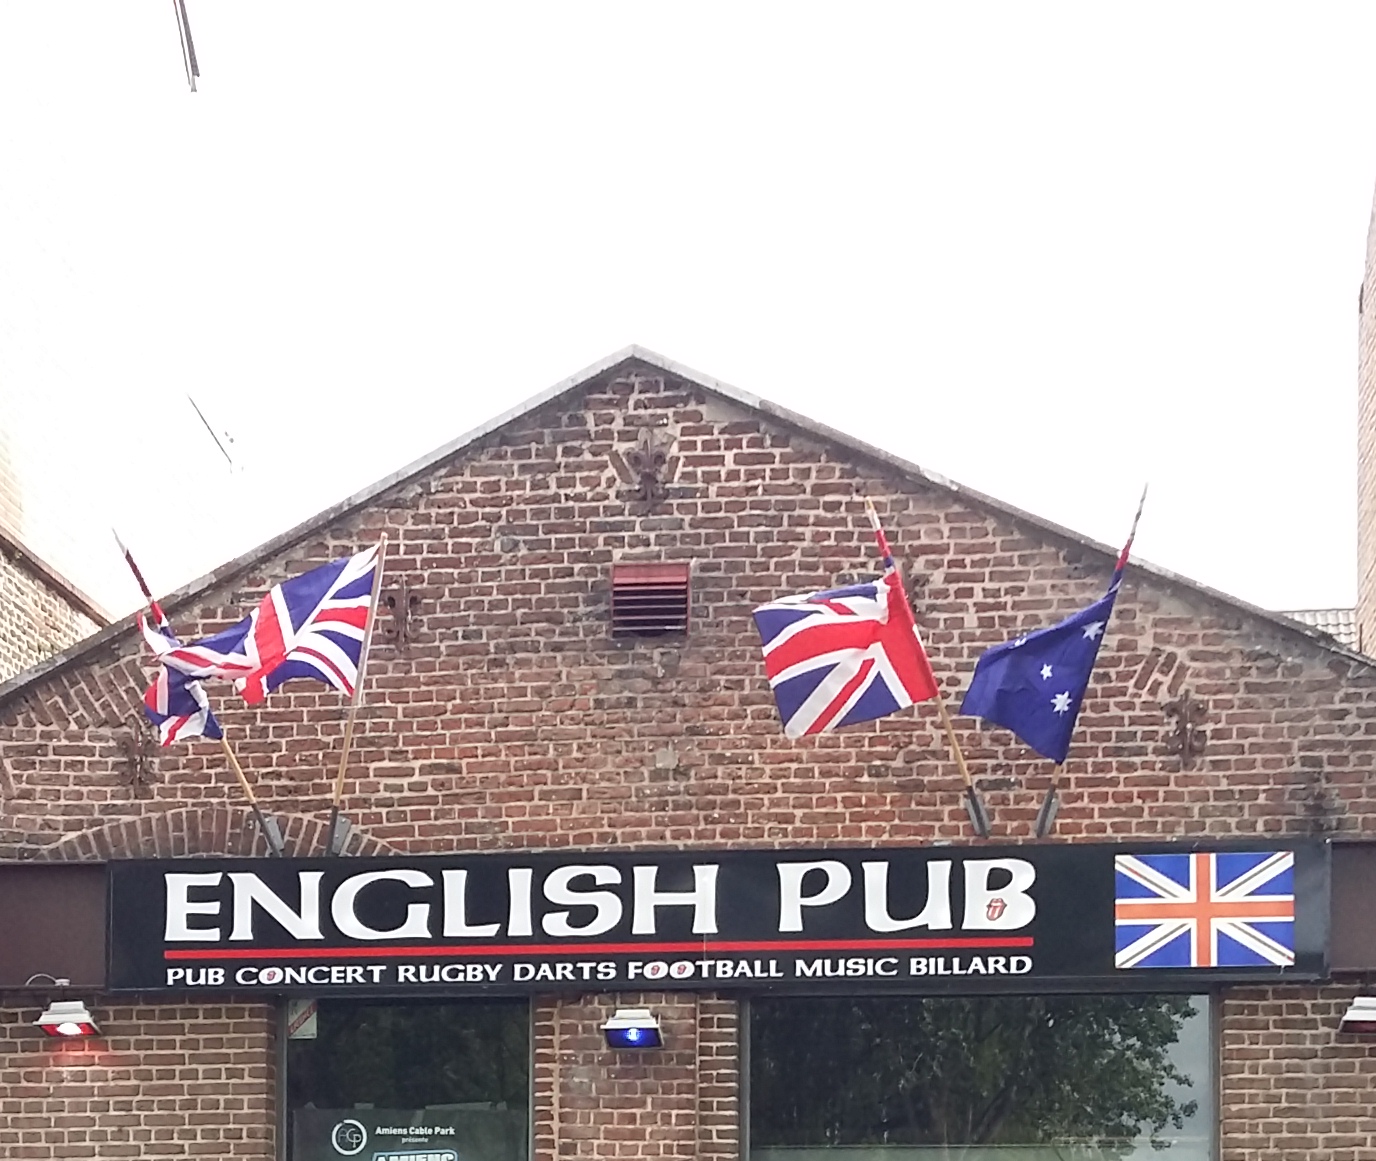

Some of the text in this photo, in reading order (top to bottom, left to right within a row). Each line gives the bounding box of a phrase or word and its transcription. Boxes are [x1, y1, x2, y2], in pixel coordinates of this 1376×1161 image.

[164, 858, 1037, 941] ENGLISH PUB
[166, 955, 1034, 986] PUB CONCERT RUGBY DARTS FOOTBALL MUSIC BILLARD
[375, 1126, 456, 1135] Amiens Cable Park
